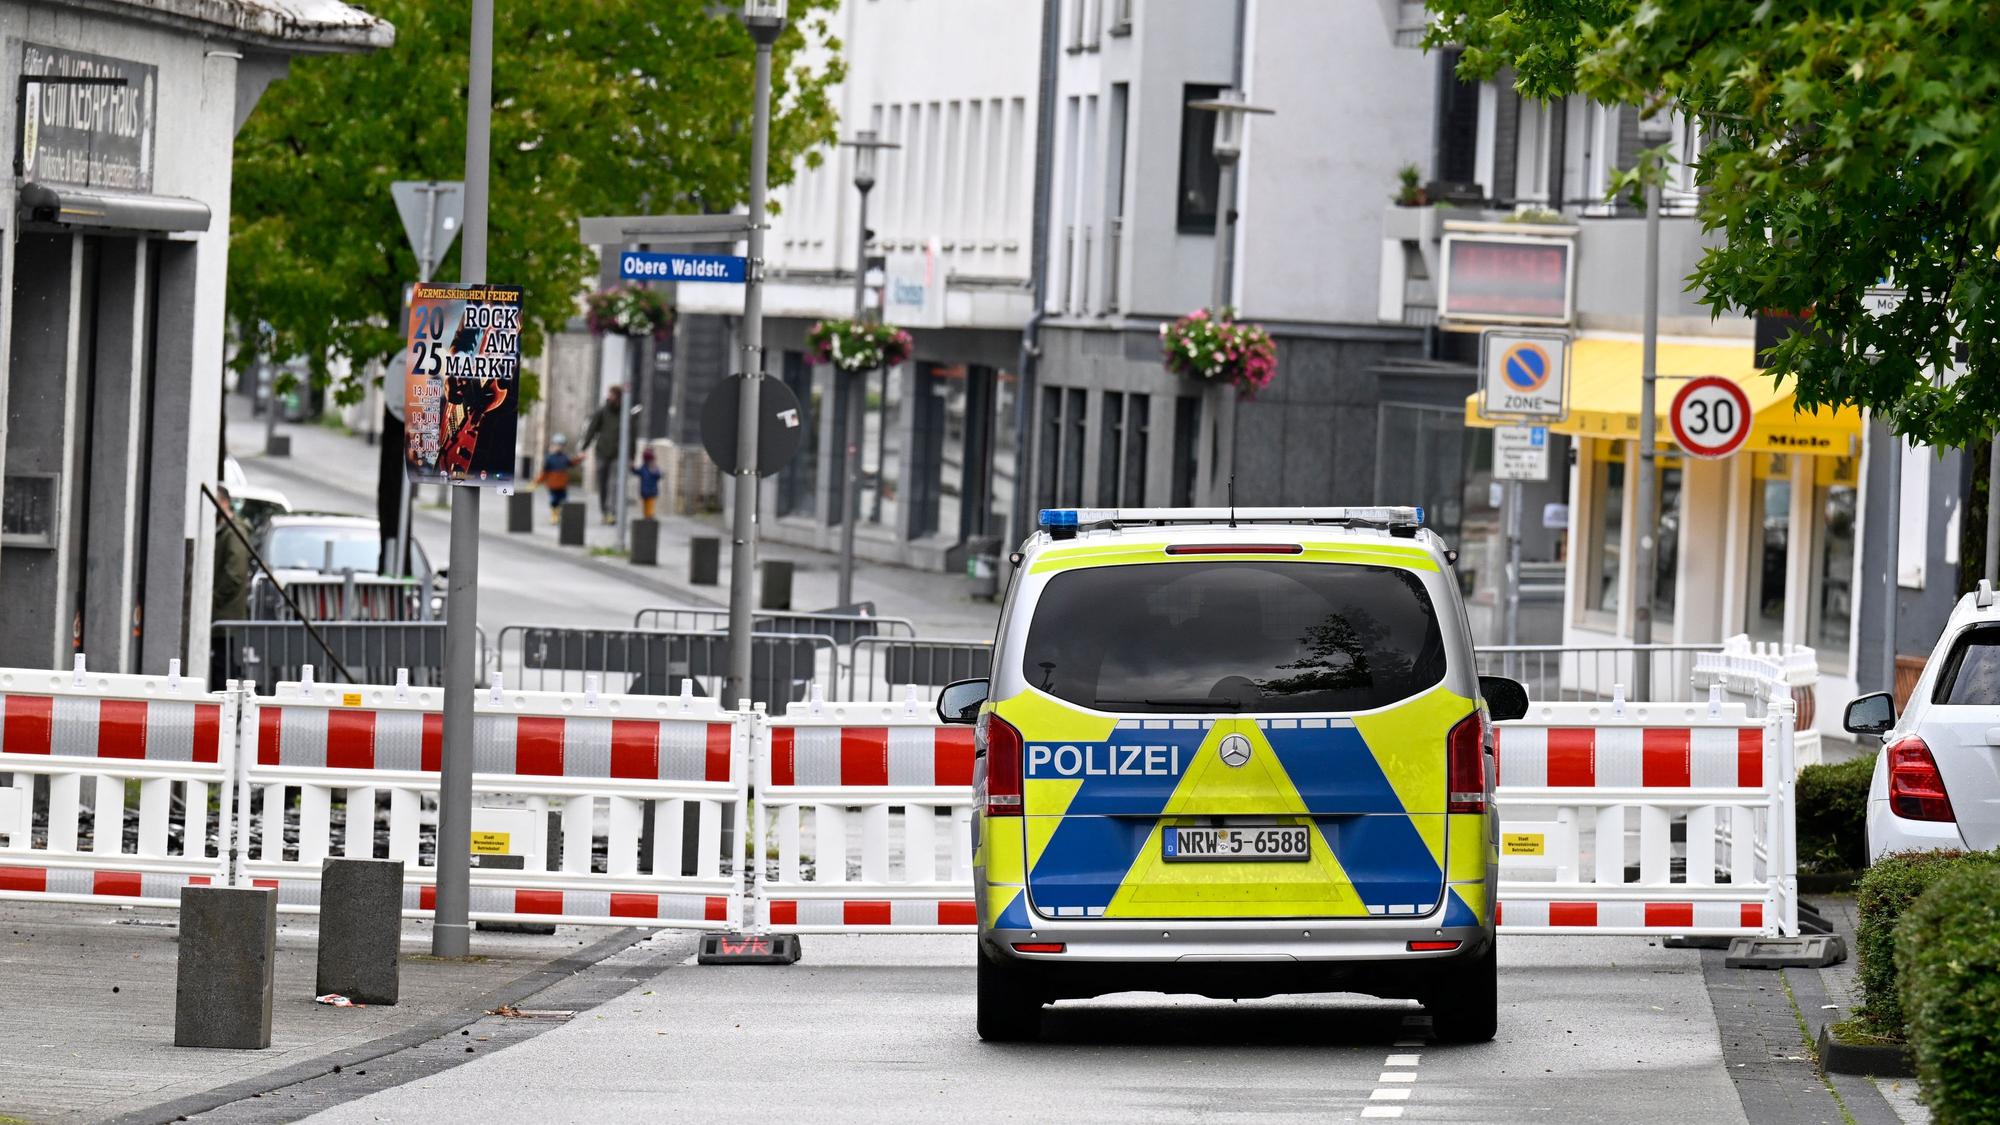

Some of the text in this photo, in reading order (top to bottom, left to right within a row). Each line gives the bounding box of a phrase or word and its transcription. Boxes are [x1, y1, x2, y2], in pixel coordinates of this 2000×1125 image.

[43, 55, 69, 127] Grill
[69, 57, 110, 132] KEBAP
[110, 65, 138, 138] Haus
[624, 256, 728, 277] Obere Waldstr.
[417, 288, 519, 301] WERMELSKIRCHEN FEIERT
[1877, 299, 1894, 309] Mo
[414, 305, 444, 341] 20
[465, 307, 517, 329] ROCK
[485, 333, 516, 354] AM
[411, 341, 442, 376] 25
[445, 356, 515, 378] MARKT
[1504, 396, 1543, 410] ZONE
[1688, 399, 1733, 434] 30
[1768, 435, 1831, 446] Miele
[1029, 745, 1178, 775] POLIZEI
[1178, 831, 1218, 854] NRW
[1230, 831, 1306, 854] 5-6588
